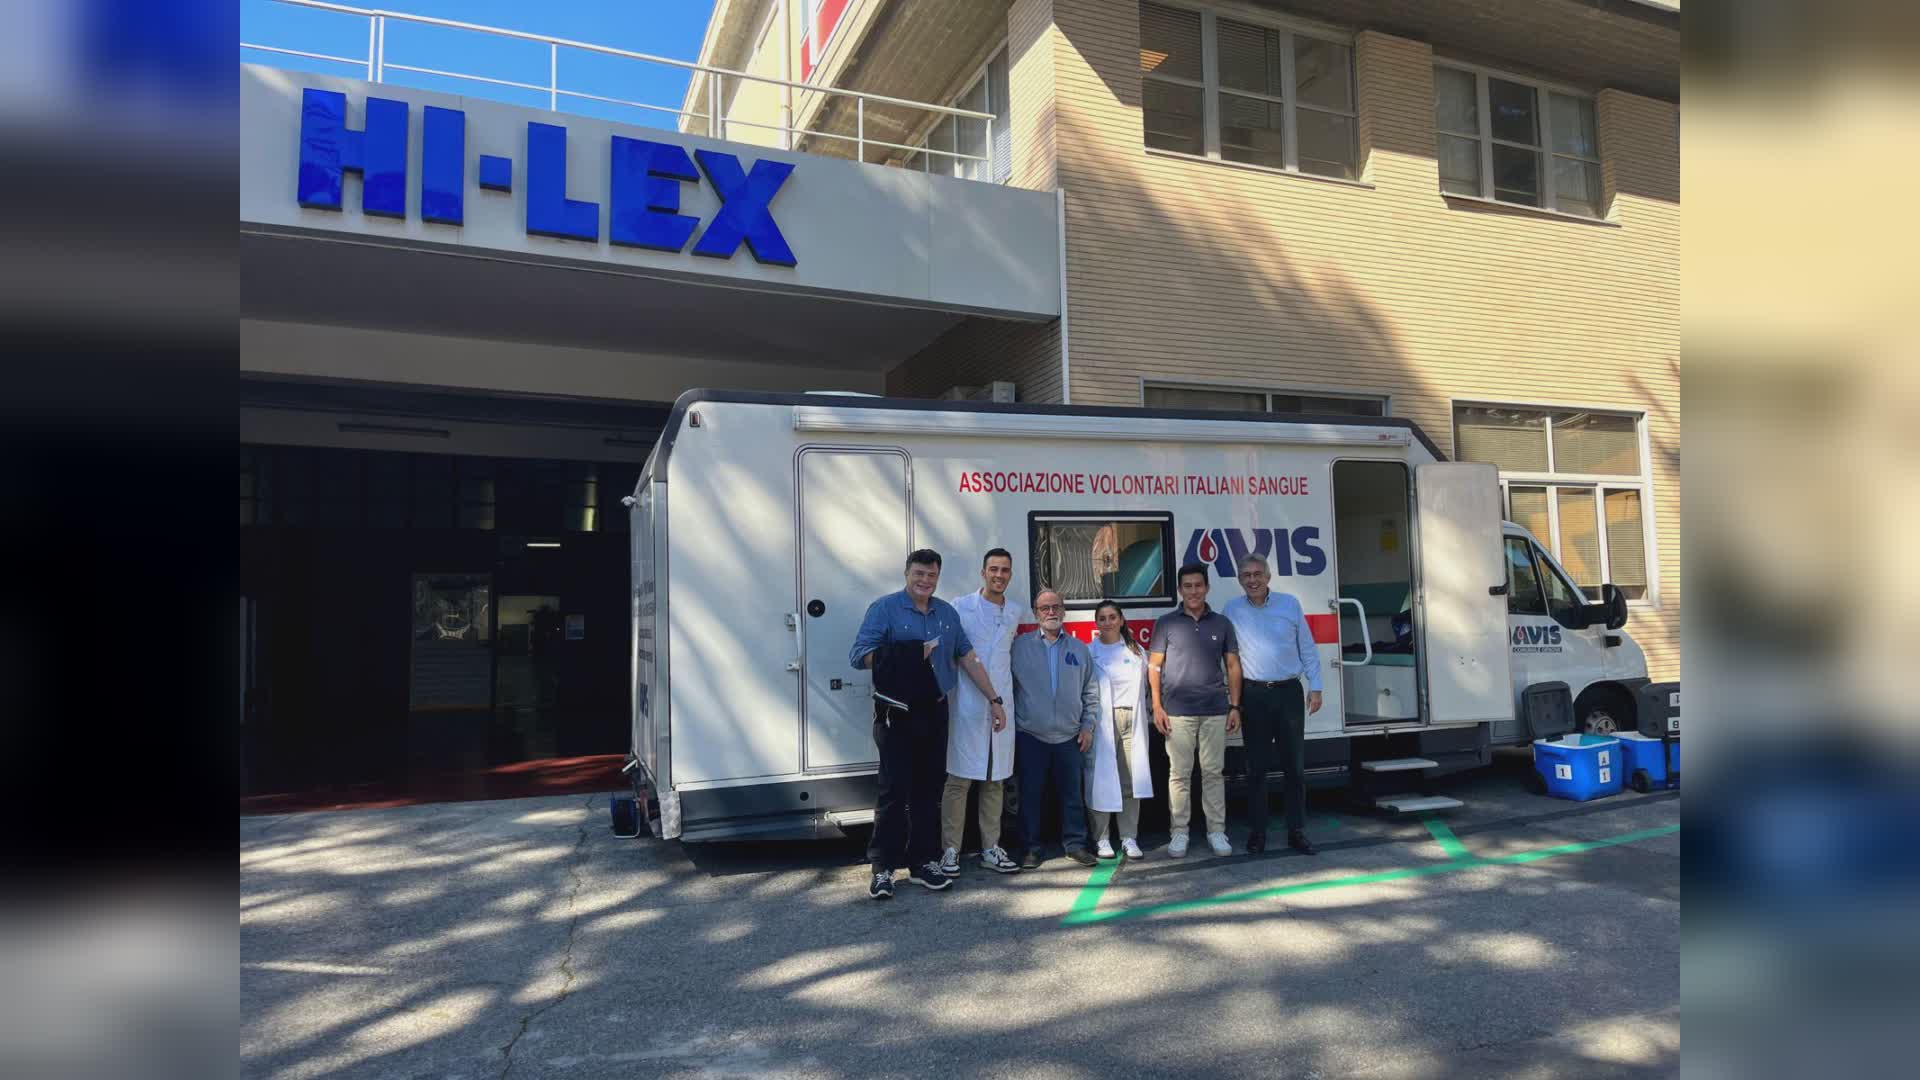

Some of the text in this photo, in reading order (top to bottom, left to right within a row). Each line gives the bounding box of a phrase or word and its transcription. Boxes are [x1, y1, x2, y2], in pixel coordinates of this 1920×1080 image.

[298, 88, 797, 268] HI-LEX
[959, 472, 1309, 496] ASSOCIAZIONE VOLONTARI ITALIANI SANGUE
[1183, 526, 1327, 577] AVIS
[1513, 625, 1561, 645] AVIS
